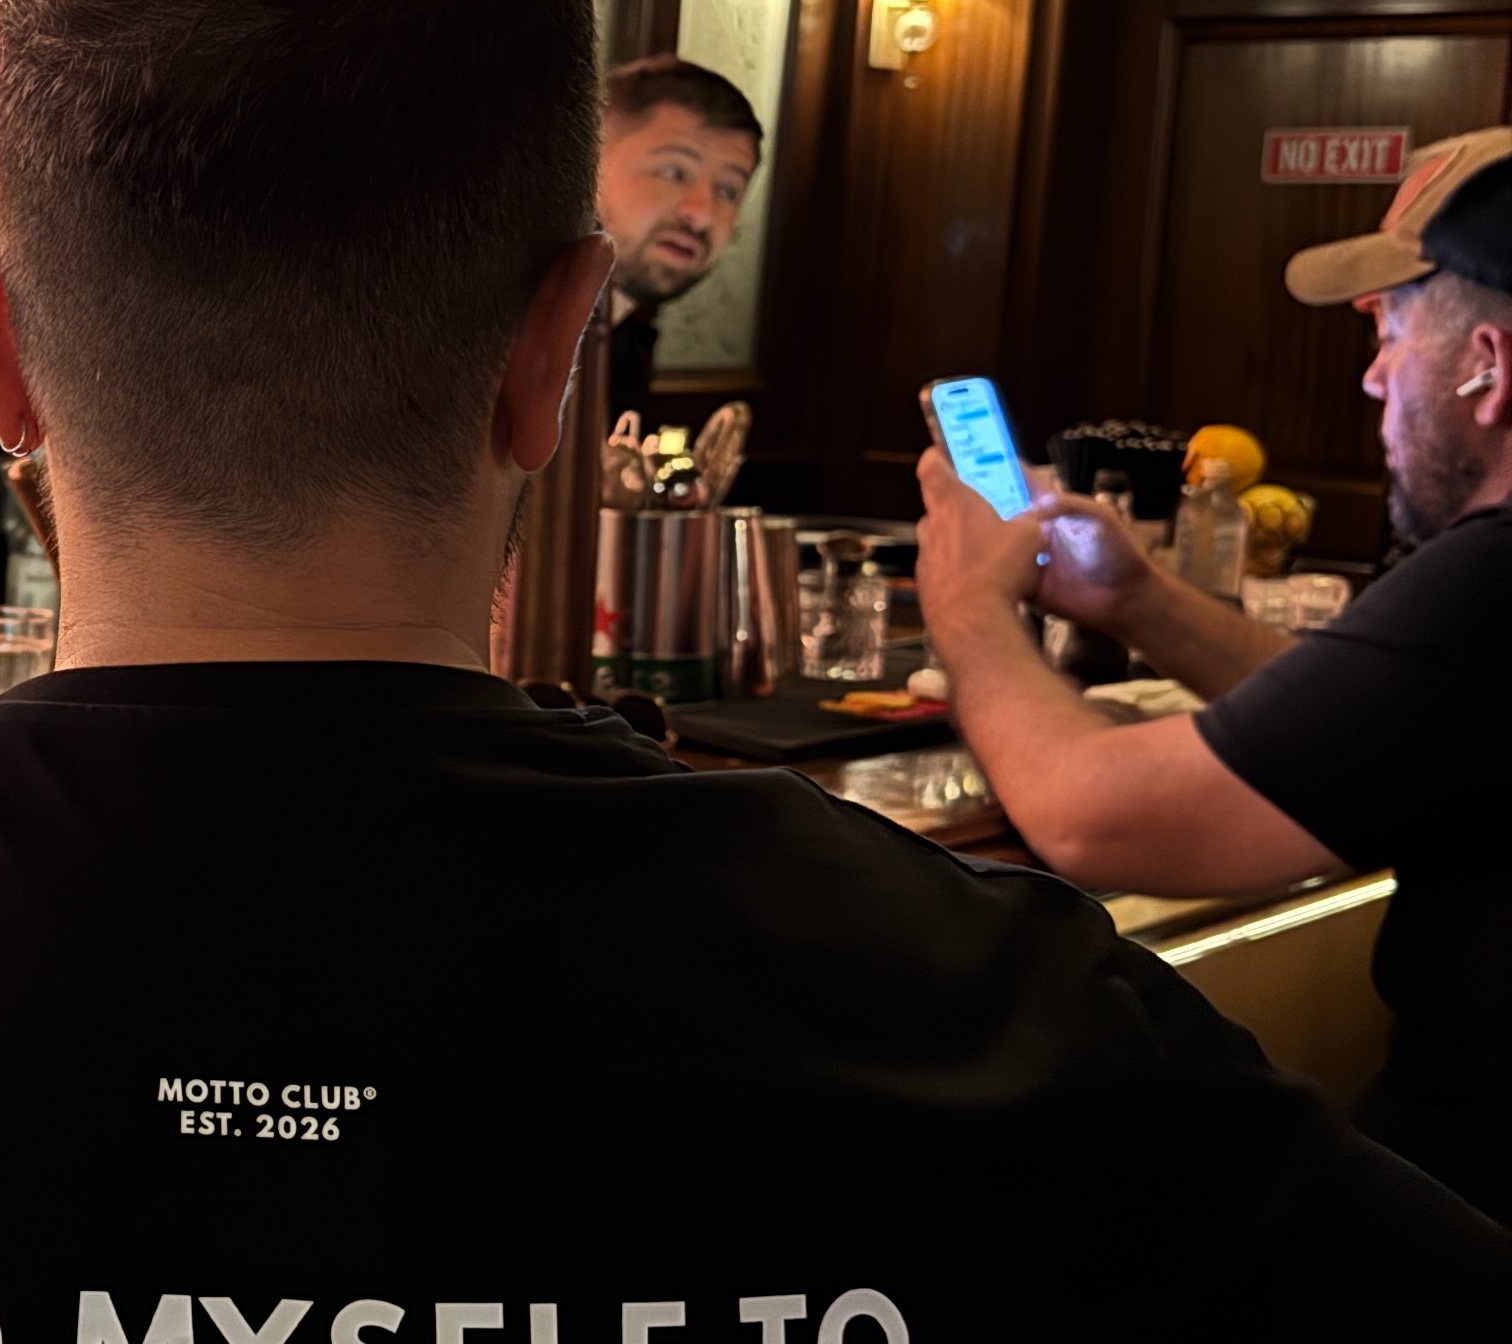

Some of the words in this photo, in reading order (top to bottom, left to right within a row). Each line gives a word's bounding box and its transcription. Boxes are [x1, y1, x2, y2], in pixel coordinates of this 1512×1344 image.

[1279, 138, 1319, 173] NO
[1323, 138, 1388, 174] EXIT
[158, 1078, 269, 1106] MOTTO
[181, 1110, 242, 1136] EST.
[256, 1114, 340, 1141] 2026
